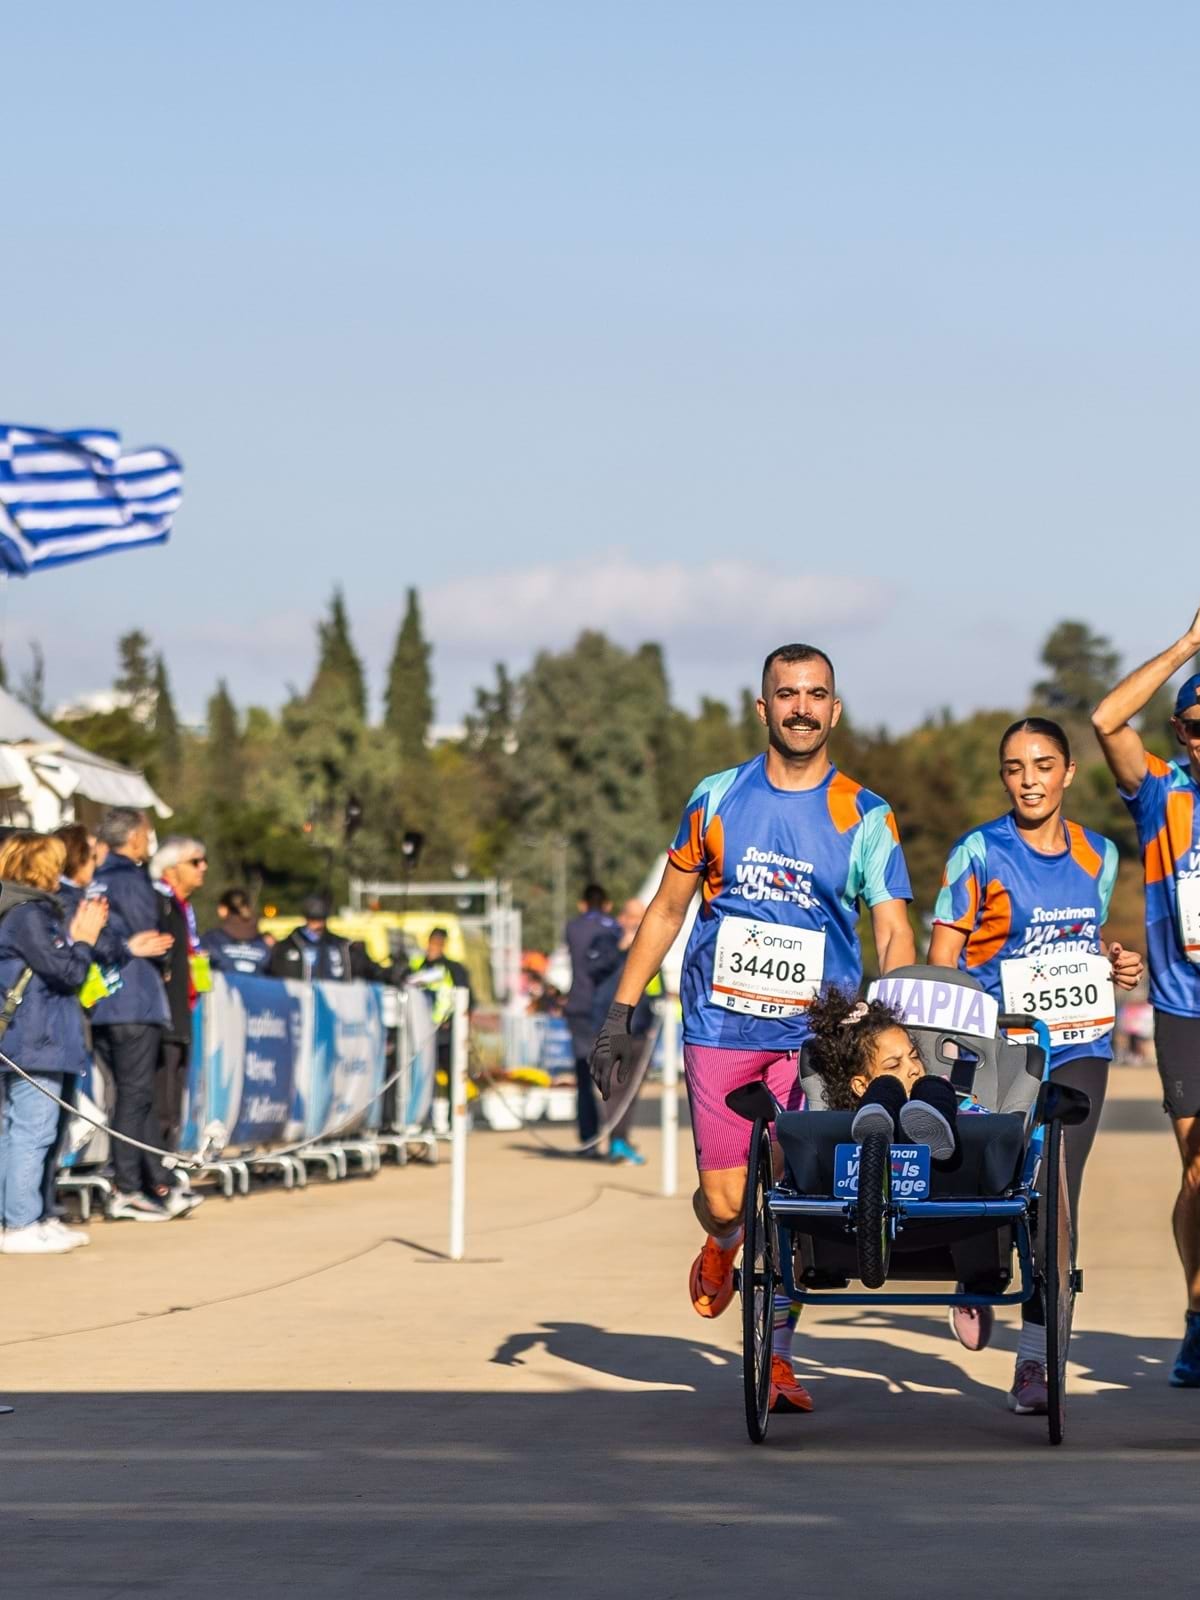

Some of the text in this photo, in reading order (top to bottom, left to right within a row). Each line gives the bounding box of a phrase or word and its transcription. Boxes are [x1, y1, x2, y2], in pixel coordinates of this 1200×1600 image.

[742, 846, 814, 874] Stoiximan
[1030, 907, 1096, 923] Stoiximan
[730, 952, 806, 983] 34408
[1022, 983, 1098, 1013] 35530
[837, 1176, 850, 1188] of
